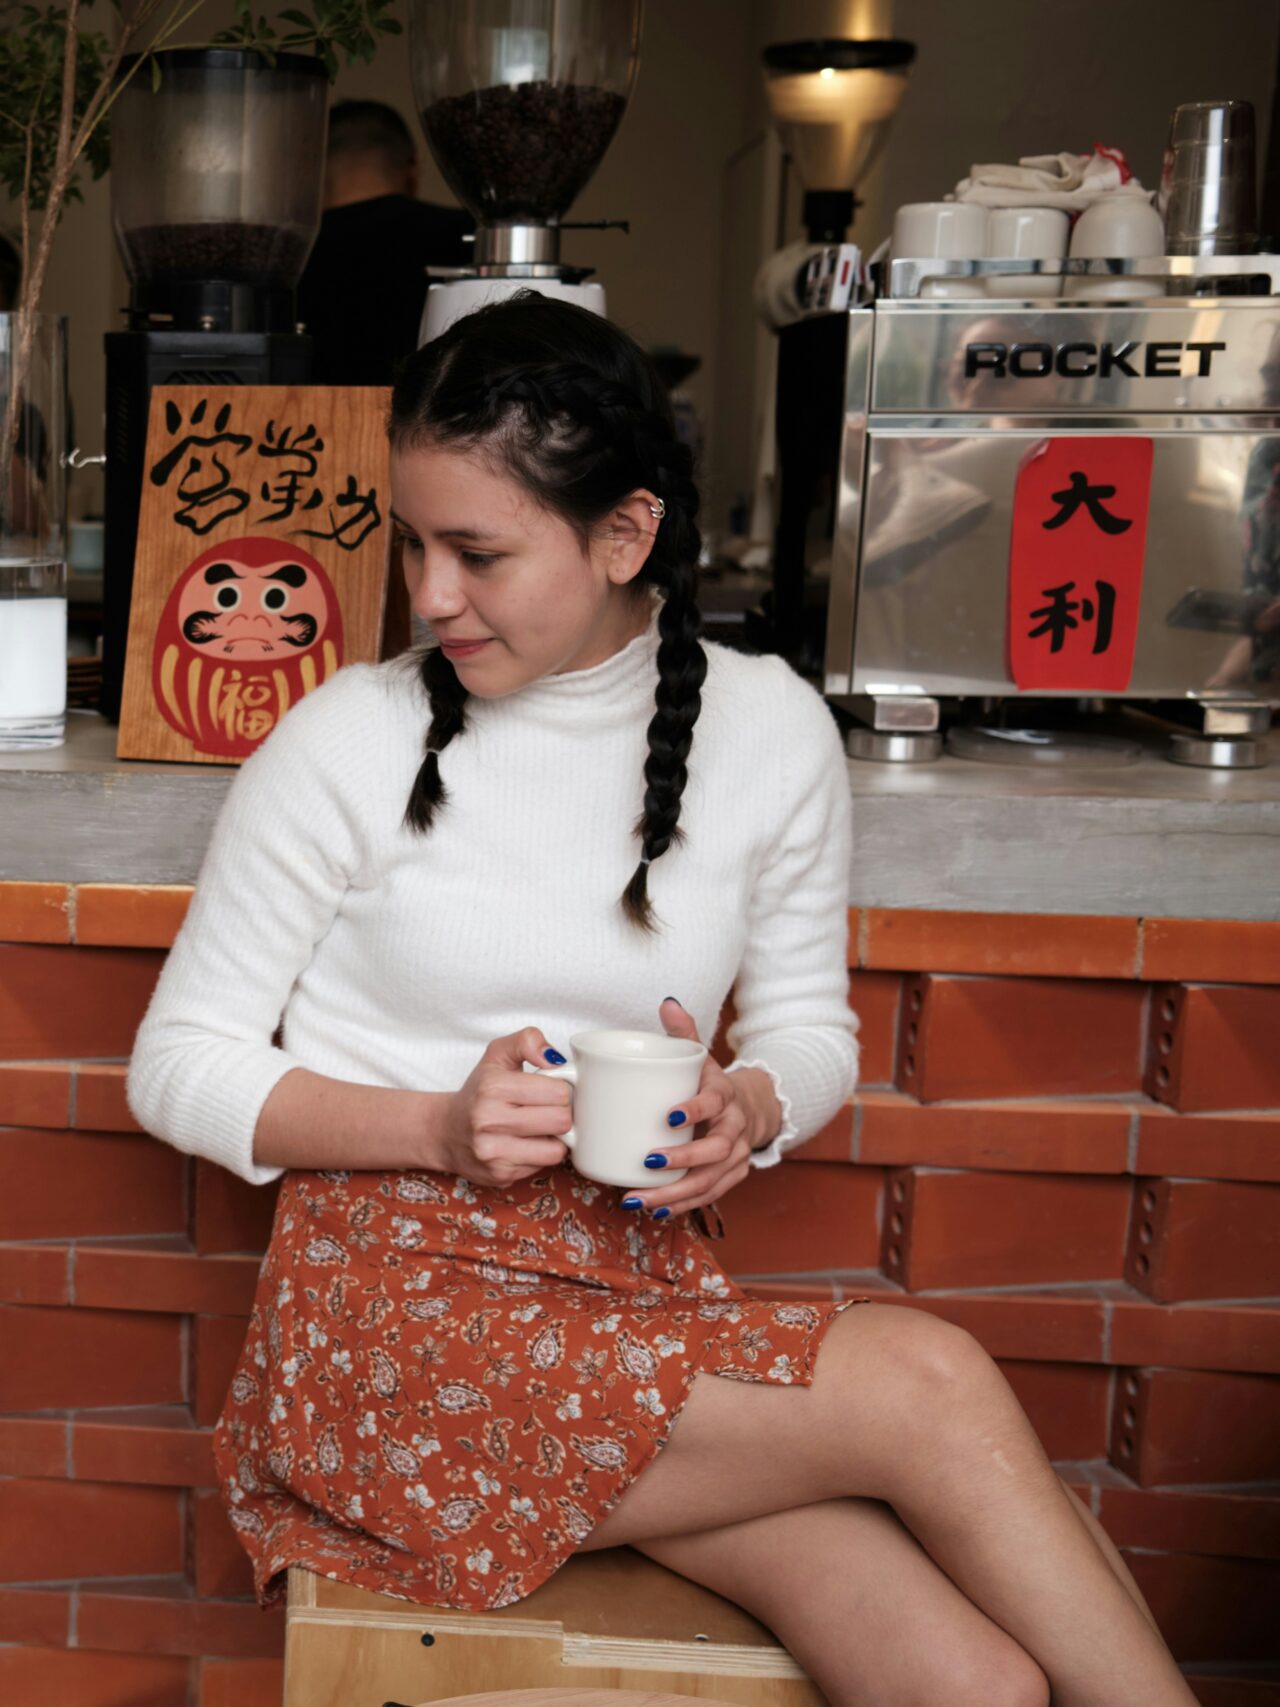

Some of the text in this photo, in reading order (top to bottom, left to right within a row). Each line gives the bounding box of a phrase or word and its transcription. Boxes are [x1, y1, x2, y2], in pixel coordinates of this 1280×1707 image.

[964, 341, 1226, 379] ROCKET
[1027, 471, 1132, 655] 大利
[220, 669, 274, 741] 福
